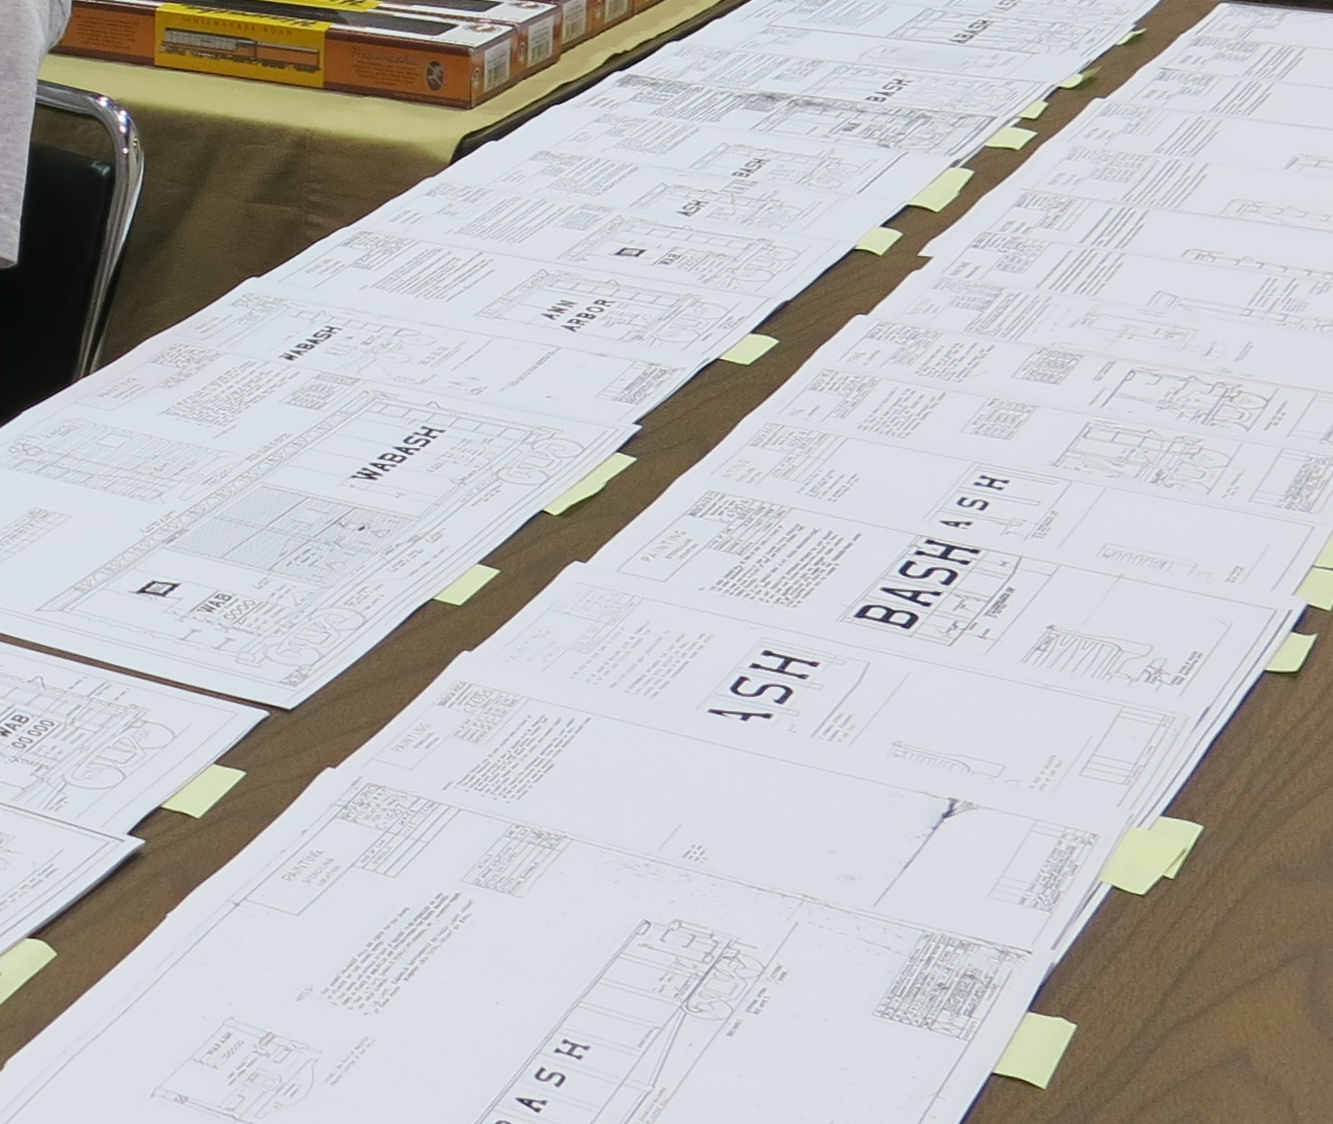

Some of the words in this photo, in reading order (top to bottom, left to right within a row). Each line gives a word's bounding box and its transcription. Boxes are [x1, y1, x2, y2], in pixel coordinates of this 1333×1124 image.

[263, 26, 294, 36] ROAD
[864, 78, 913, 103] BASH
[541, 299, 578, 320] ANN
[561, 299, 616, 333] ARBOR
[278, 325, 343, 362] WABASH
[350, 426, 446, 482] WABASH
[854, 539, 981, 630] BASH
[197, 592, 233, 614] WAB
